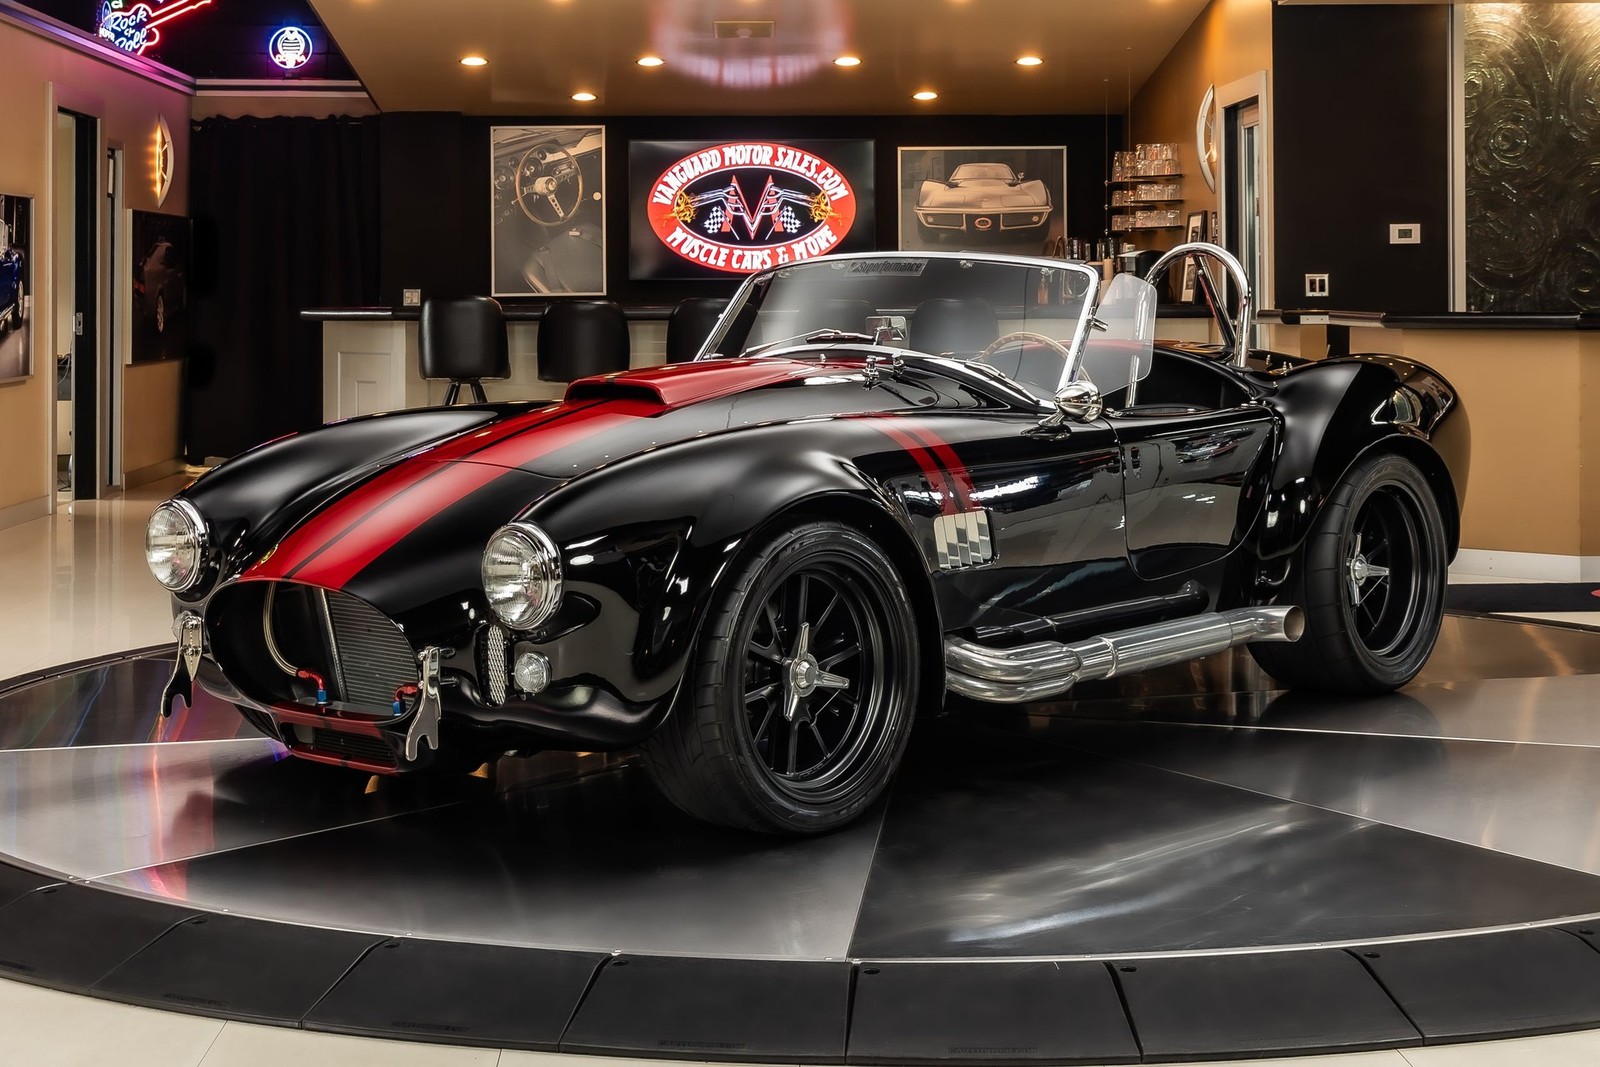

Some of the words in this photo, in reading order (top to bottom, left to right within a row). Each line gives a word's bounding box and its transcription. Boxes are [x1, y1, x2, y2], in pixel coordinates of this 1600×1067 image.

[111, 6, 147, 31] Rock
[653, 149, 722, 205] VANGUARD
[722, 145, 773, 166] MOTOR
[774, 147, 850, 201] SALES.COM
[666, 227, 728, 267] MUSCLE
[731, 249, 772, 270] CARS
[776, 247, 790, 264] &
[793, 224, 838, 261] MORE
[859, 261, 922, 274] Superformance
